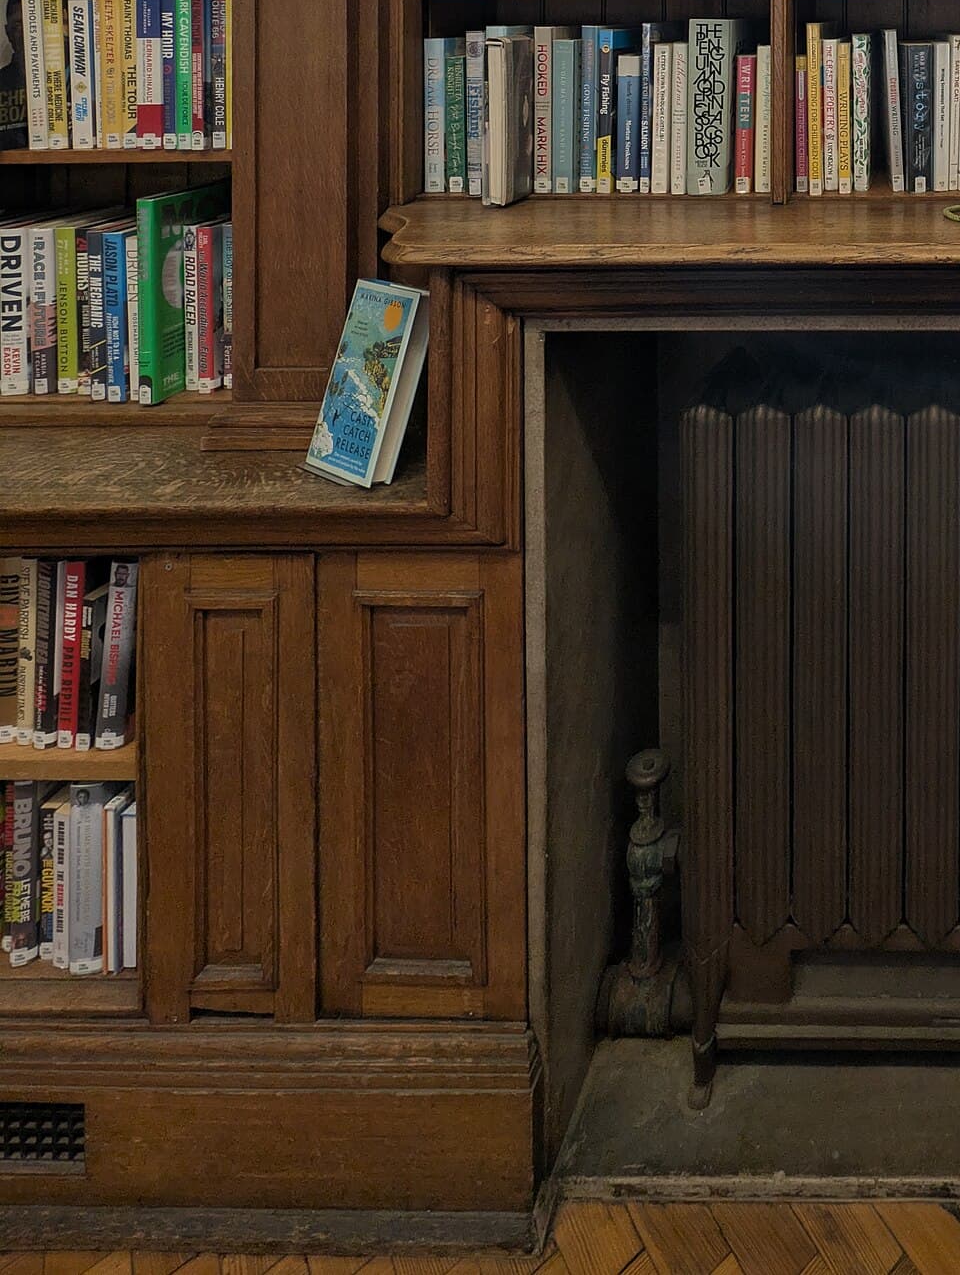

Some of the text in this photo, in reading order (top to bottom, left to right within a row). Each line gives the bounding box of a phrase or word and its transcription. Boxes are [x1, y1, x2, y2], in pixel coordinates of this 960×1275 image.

[50, 0, 58, 24] RICHARD
[161, 12, 173, 59] MY HOUR
[73, 6, 86, 77] SEAN CONWAY
[105, 25, 114, 64] SKELTER
[179, 17, 188, 73] CAVENDISH
[31, 53, 40, 98] PAVEMENTS
[53, 70, 61, 92] WHERE
[127, 65, 136, 119] THE TOUR
[215, 78, 224, 125] HENRY COLE
[600, 74, 610, 114] Fly Fishing
[741, 65, 750, 122] WRITTEN
[427, 58, 439, 156] DREAM HORSE
[468, 85, 482, 139] Fishing
[537, 45, 547, 174] HOOKED MARK HIX
[914, 82, 928, 132] story
[840, 141, 848, 171] PLAYS
[1, 236, 22, 332] DRIVEN
[34, 242, 46, 346] RACE FUTURE
[89, 255, 102, 328] THE MECHANIC
[105, 238, 119, 307] JASON PLATO
[185, 256, 195, 325] ROAD RACER
[60, 281, 68, 372] JENSON BUTTON
[4, 347, 13, 376] EASON
[12, 348, 20, 373] KEVIN
[343, 424, 370, 443] CATCH
[350, 411, 371, 427] CAST
[336, 436, 370, 460] RELEASE
[20, 567, 30, 640] STEVE PARRISH
[64, 575, 78, 642] DAN HARDY
[107, 591, 124, 685] MICHAEL BISPING
[14, 798, 32, 876] BRUNO
[13, 881, 21, 922] FRANK
